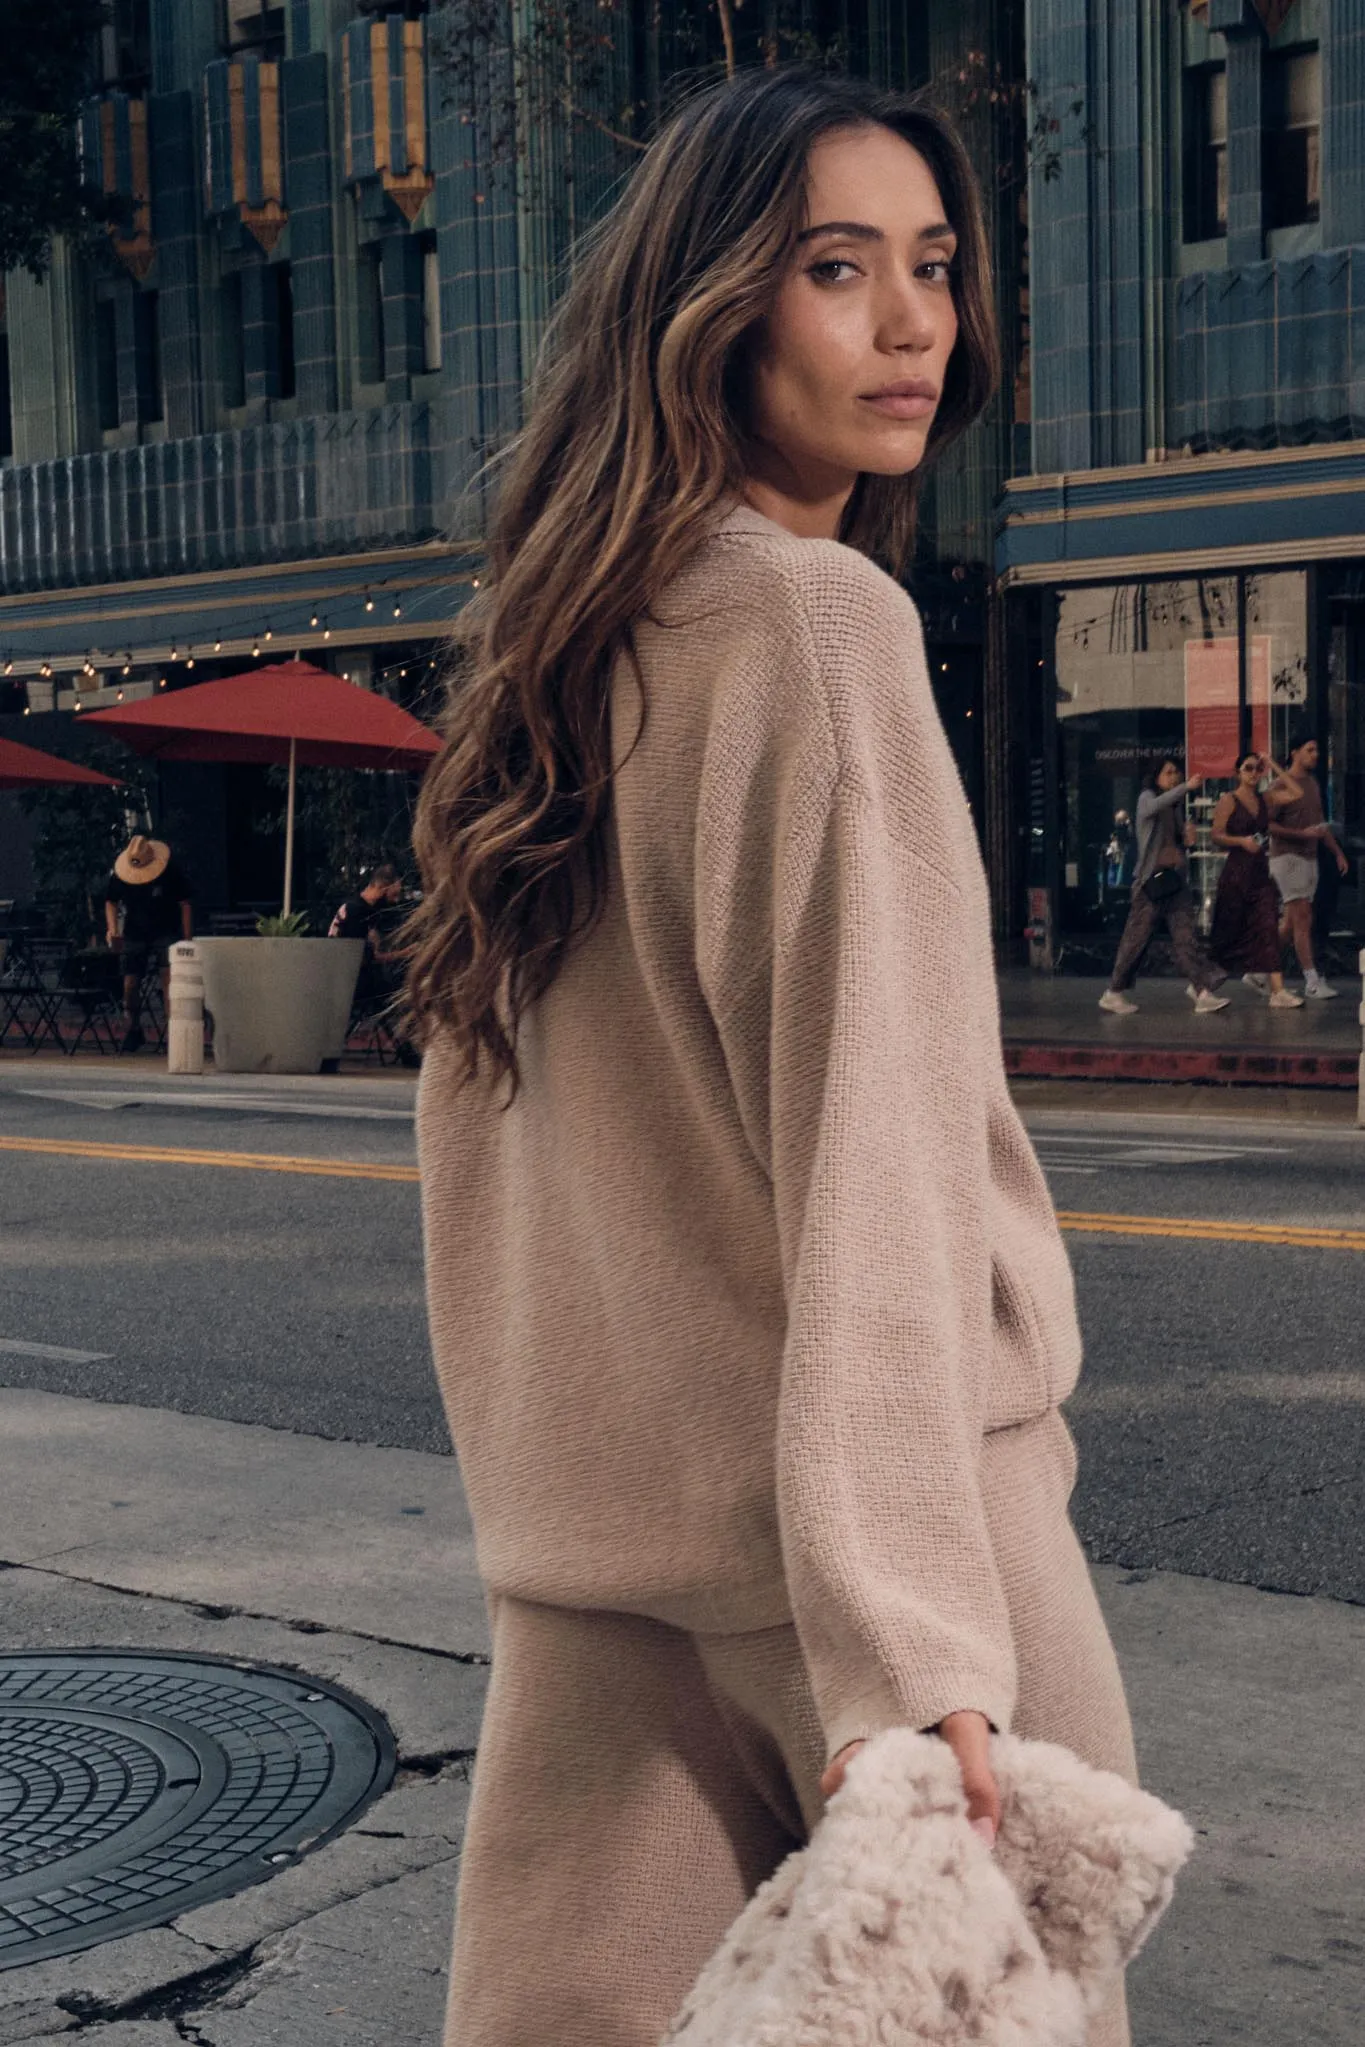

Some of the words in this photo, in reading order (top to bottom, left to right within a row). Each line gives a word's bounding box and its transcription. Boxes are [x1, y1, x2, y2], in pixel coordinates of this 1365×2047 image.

[1135, 748, 1151, 758] THE
[1153, 747, 1173, 757] NEW
[1173, 745, 1224, 758] COLECTION
